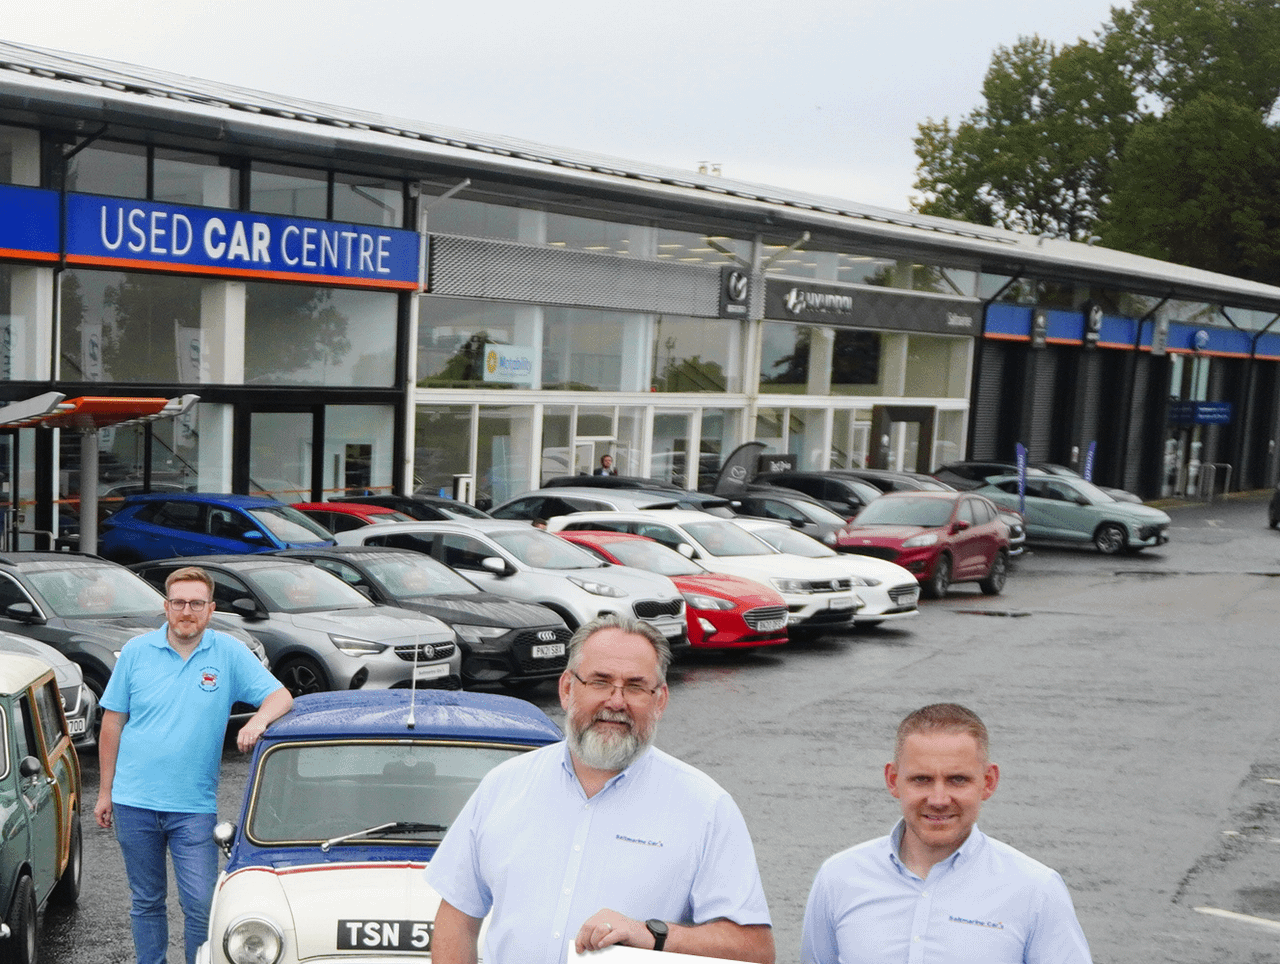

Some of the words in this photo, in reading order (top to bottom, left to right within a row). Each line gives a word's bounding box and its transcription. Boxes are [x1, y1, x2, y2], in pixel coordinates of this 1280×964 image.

[101, 206, 193, 255] USED
[204, 218, 271, 263] CAR
[281, 226, 392, 274] CENTRE
[346, 922, 400, 947] TSN
[410, 923, 434, 948] 5
